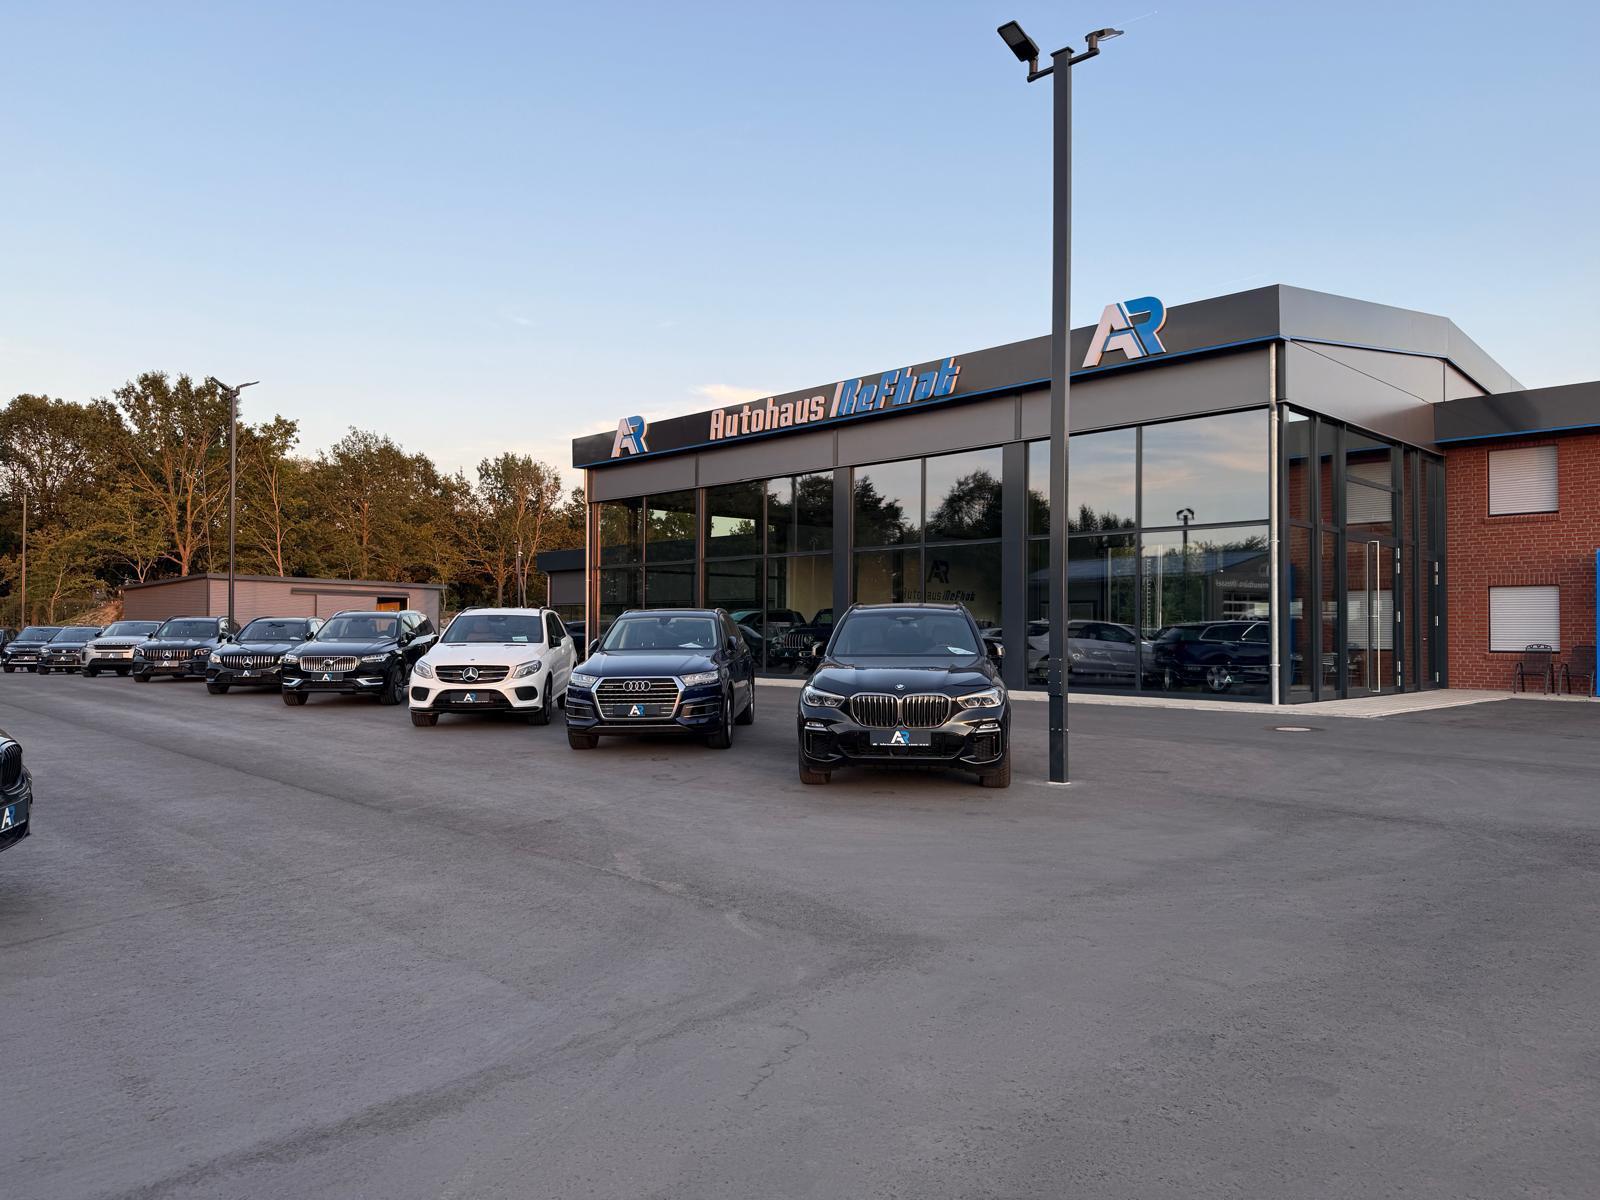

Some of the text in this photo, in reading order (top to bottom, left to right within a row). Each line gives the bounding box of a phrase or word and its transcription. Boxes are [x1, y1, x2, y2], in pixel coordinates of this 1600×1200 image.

[1082, 296, 1167, 368] AR
[611, 415, 648, 458] AR
[709, 396, 825, 440] Autohaus
